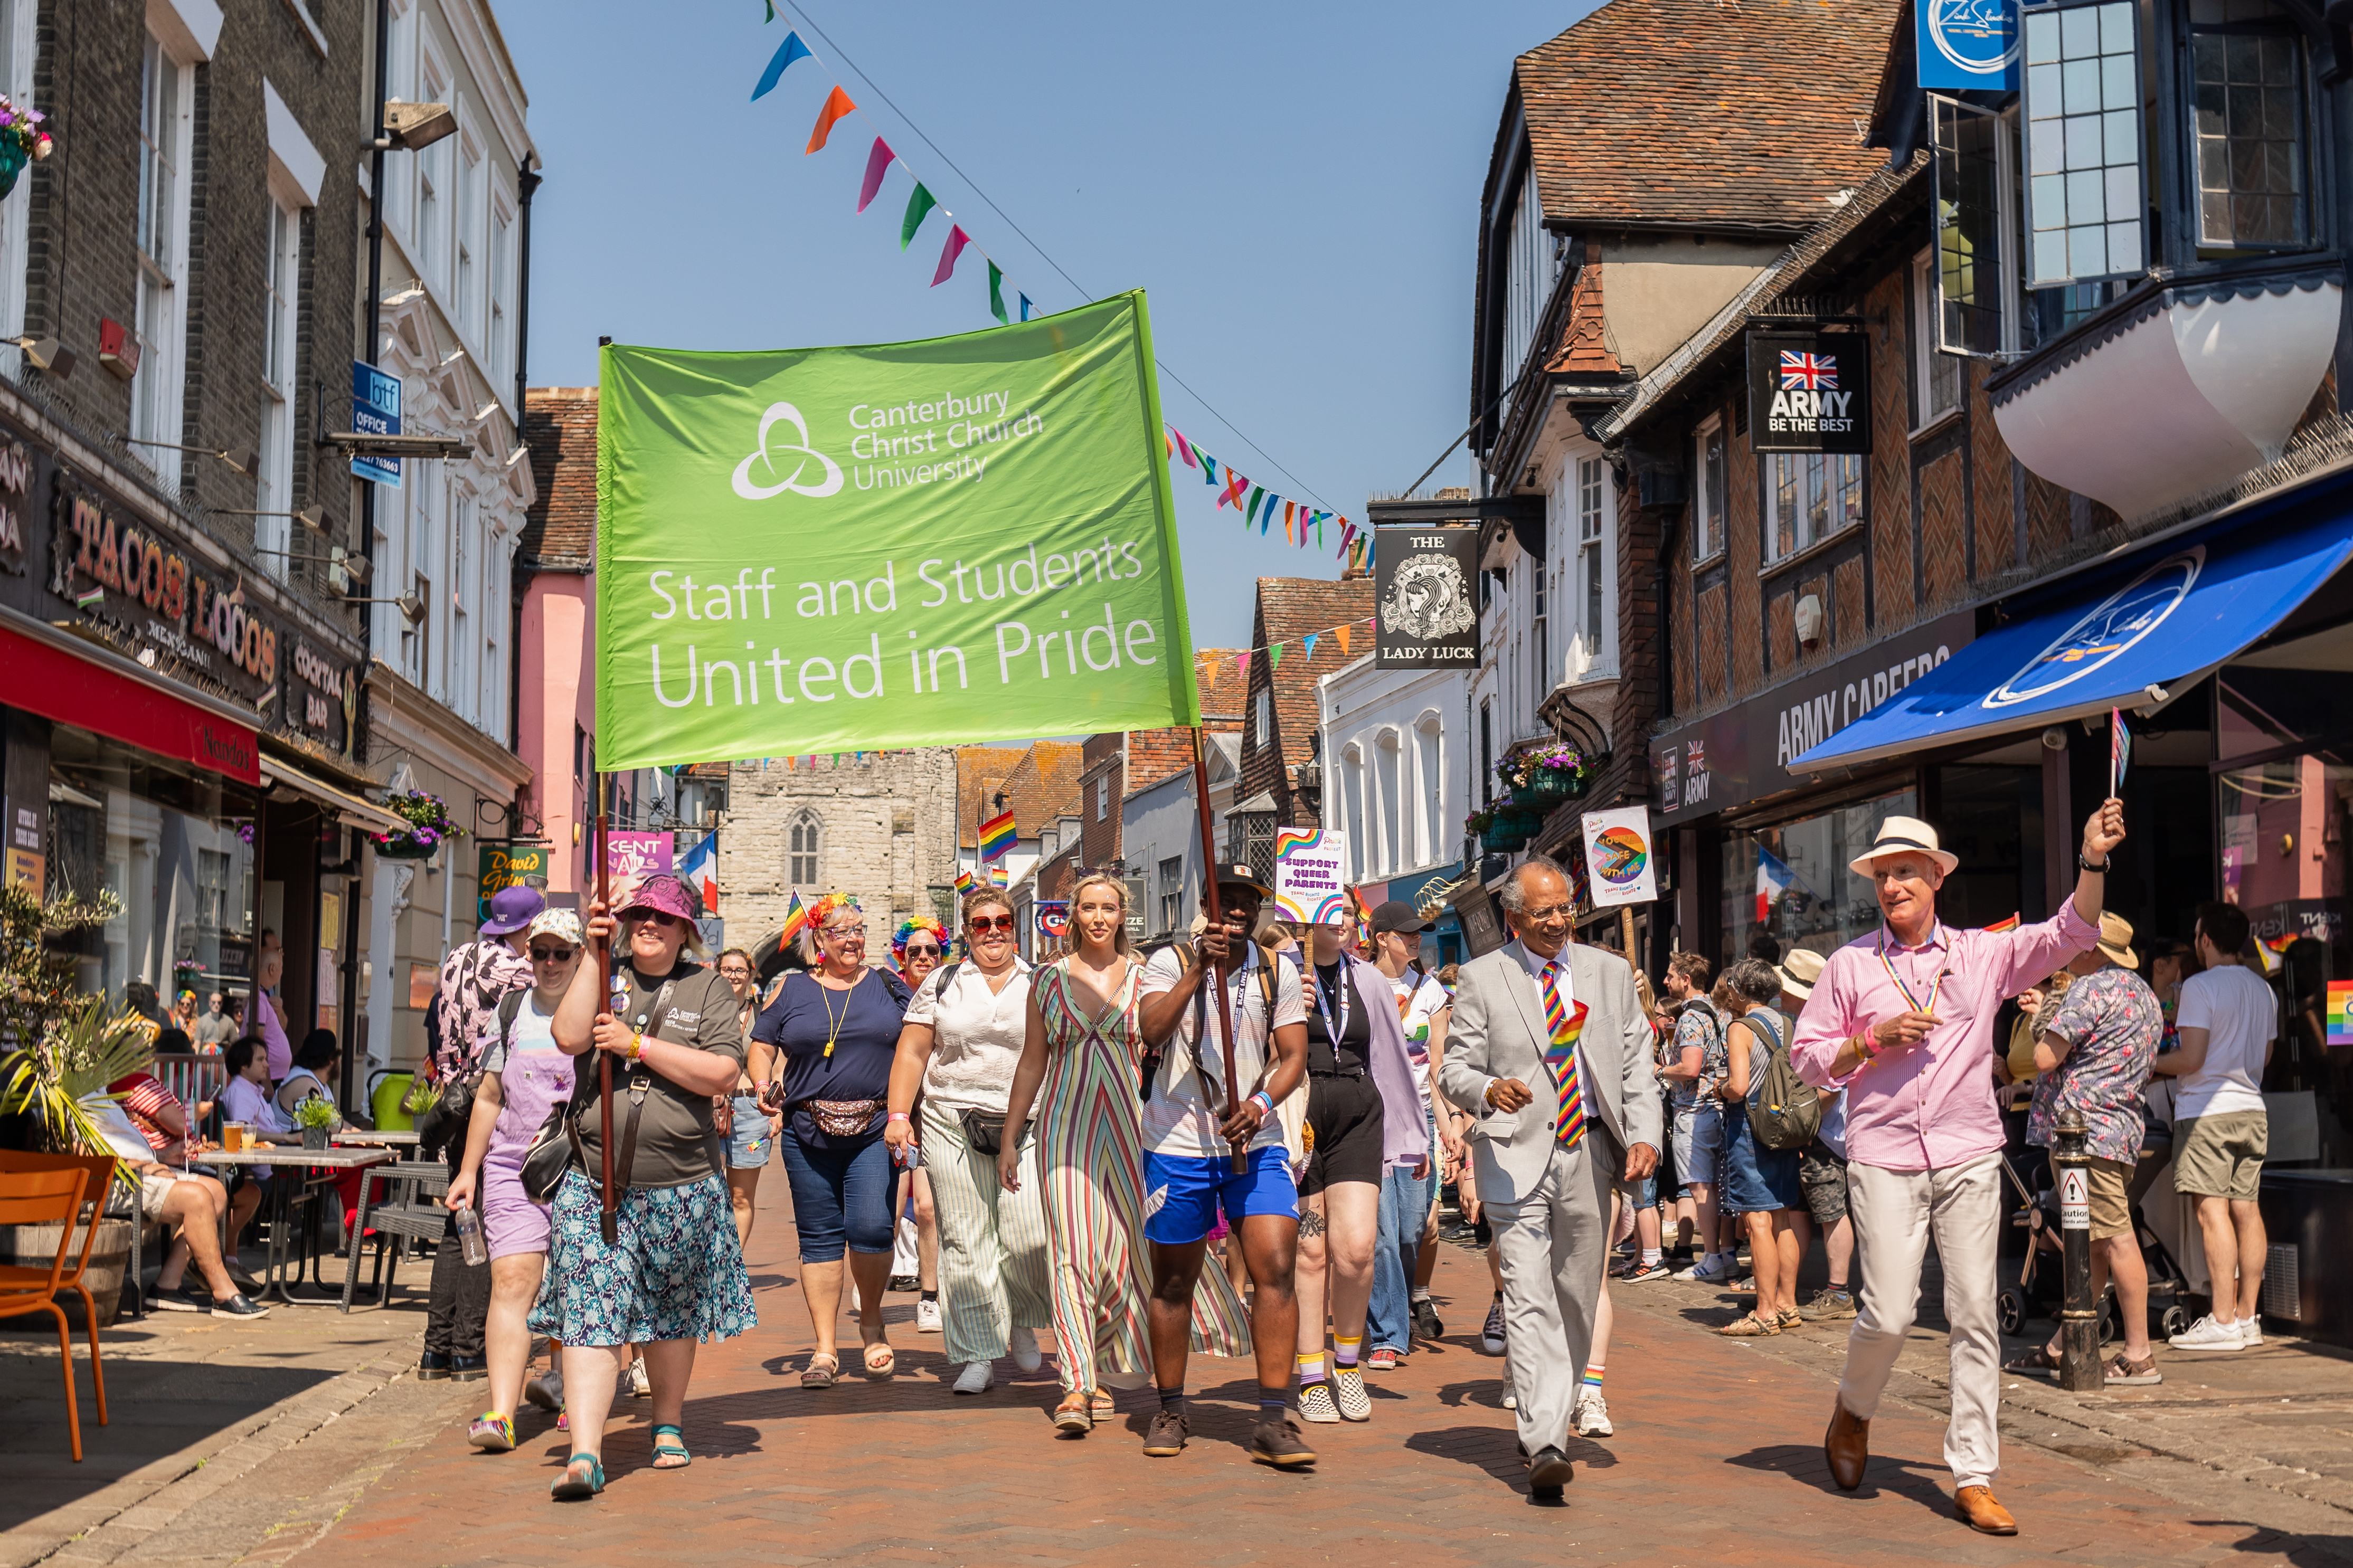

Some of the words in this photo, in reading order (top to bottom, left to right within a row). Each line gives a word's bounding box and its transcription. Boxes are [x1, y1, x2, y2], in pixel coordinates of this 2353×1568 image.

[372, 377, 395, 411] btf
[1769, 390, 1852, 417] ARMY
[848, 390, 1009, 430] Canterbury
[356, 412, 387, 435] OFFICE
[851, 429, 938, 460] Christ
[947, 409, 1044, 448] Church
[1769, 417, 1787, 432] BE
[1788, 417, 1817, 432] THE
[1819, 418, 1854, 432] BEST
[375, 457, 398, 473] 763663
[854, 452, 988, 490] University
[1410, 536, 1445, 548] THE
[73, 496, 185, 620] TACOS
[194, 576, 276, 685] LOCOS
[650, 567, 776, 620] Staff
[797, 560, 897, 617] and
[919, 536, 1142, 607] Students
[651, 633, 884, 707] United
[909, 630, 968, 693] in
[995, 602, 1157, 684] Pride
[1383, 647, 1428, 659] LADY
[1432, 647, 1475, 659] LUCK
[295, 644, 342, 702] COCKTAIL
[306, 692, 328, 731] BAR
[1778, 690, 1837, 766] ARMY
[203, 726, 249, 771] Nando's
[1665, 779, 1676, 791] ROYAL
[1665, 788, 1676, 802] NAVY
[1685, 771, 1709, 806] ARMY
[488, 851, 540, 871] David
[1286, 858, 1338, 869] SUPPORT
[1605, 850, 1630, 861] SAFE
[1293, 869, 1330, 878] QUEER
[1600, 864, 1625, 878] WITH
[1627, 861, 1641, 876] ME
[1285, 879, 1337, 890] PARENTS
